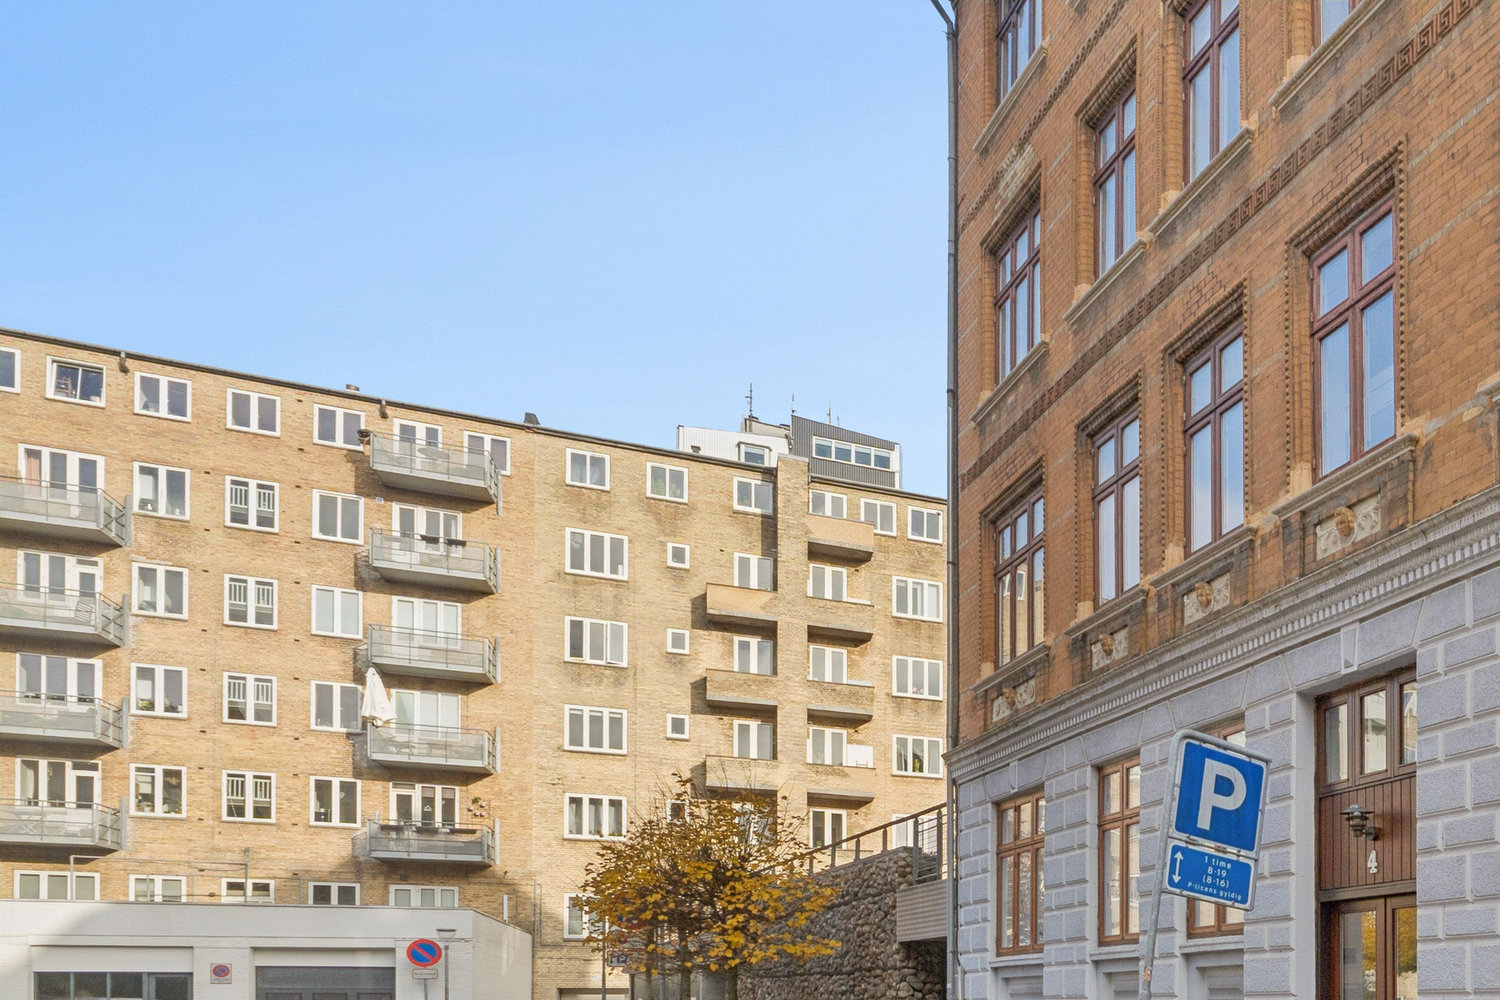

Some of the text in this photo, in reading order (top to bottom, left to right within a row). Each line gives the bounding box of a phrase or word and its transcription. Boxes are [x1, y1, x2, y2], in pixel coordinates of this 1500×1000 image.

[1197, 757, 1247, 831] P
[1204, 855, 1232, 870] 1 time
[1368, 849, 1378, 874] 4
[1207, 866, 1227, 877] 8-19
[1202, 874, 1230, 889] (8-16)
[1219, 889, 1242, 901] gyldig
